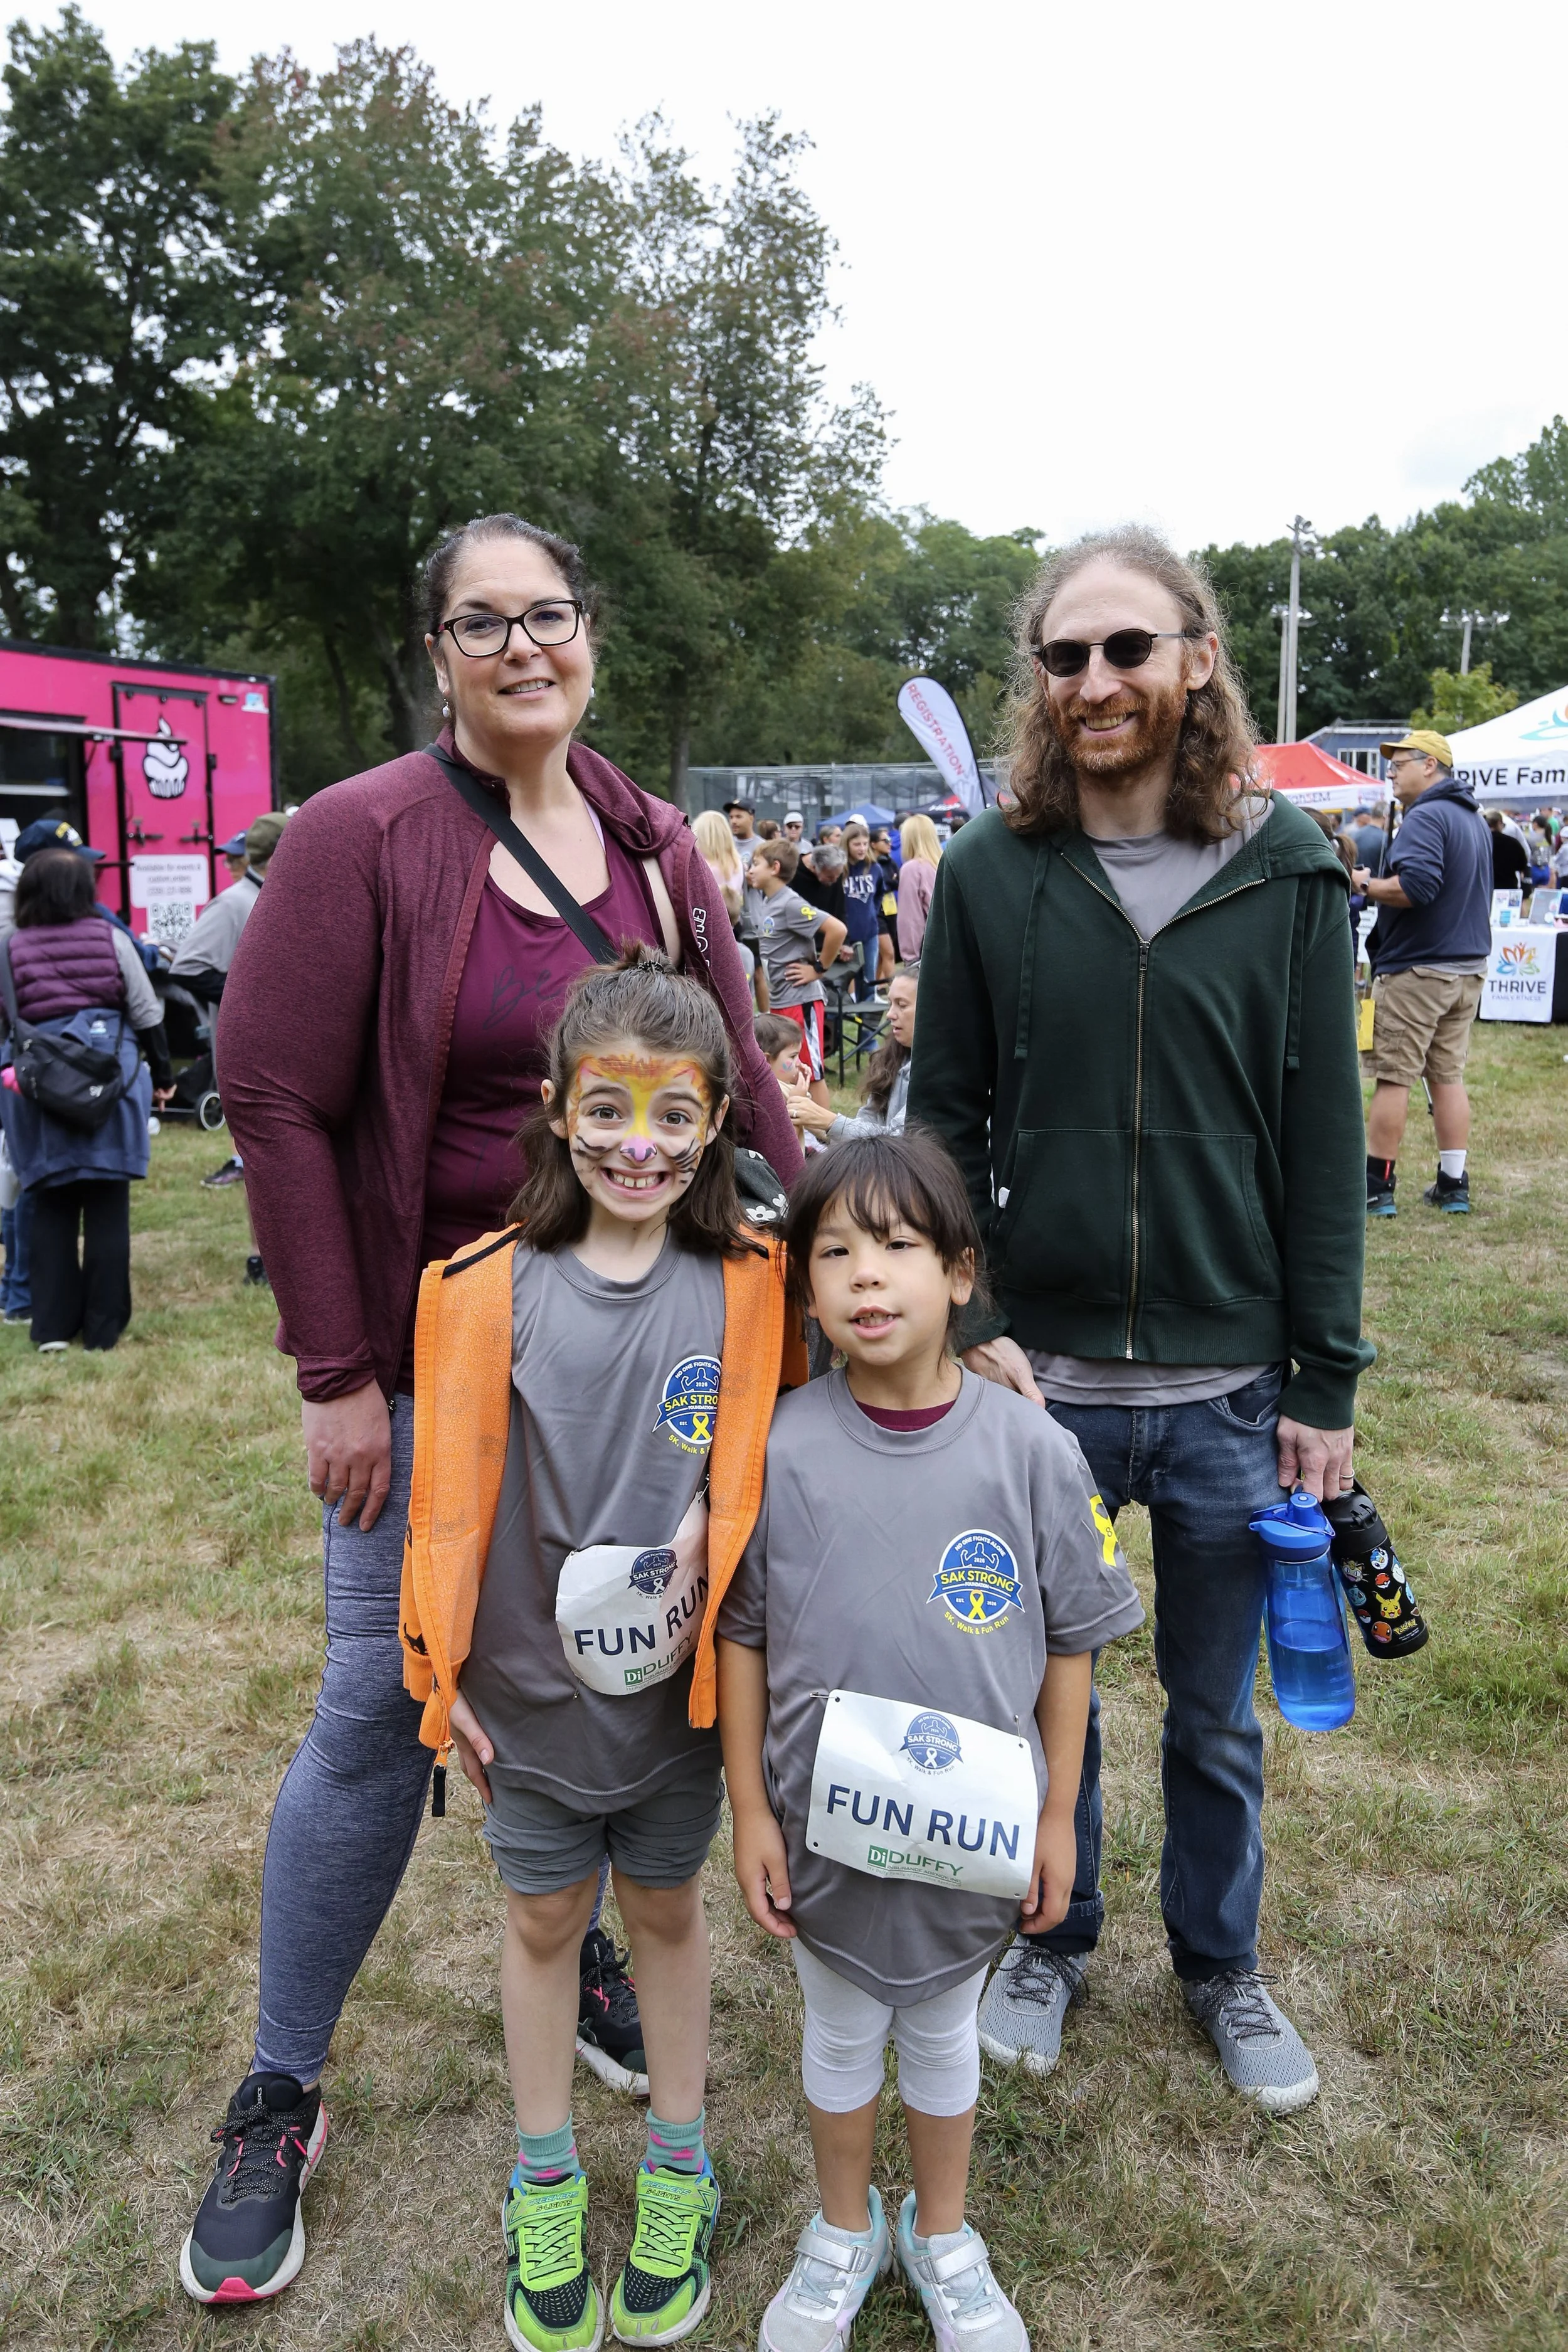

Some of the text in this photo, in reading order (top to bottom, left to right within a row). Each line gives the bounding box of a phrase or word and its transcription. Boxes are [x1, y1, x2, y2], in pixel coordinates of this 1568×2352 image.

[907, 682, 965, 776] REGISTRATION
[1452, 767, 1568, 787] RIVE Fam
[1488, 980, 1547, 994] THRIVE
[682, 1363, 693, 1372] ONE
[664, 1394, 718, 1411] SAK STRO
[669, 1434, 679, 1447] 5K,
[681, 1443, 697, 1454] Walk
[955, 1542, 963, 1551] NO
[990, 1540, 1007, 1557] ALONE
[633, 1562, 675, 1581] SAK STRONG
[941, 1570, 1015, 1592] SAK STRONG
[944, 1611, 955, 1625] 5K,
[956, 1621, 973, 1634] Walk
[981, 1626, 993, 1634] Fun
[994, 1616, 1009, 1628] Run
[574, 1624, 656, 1656] FUN
[626, 1671, 642, 1683] Di
[643, 1631, 693, 1675] DUFFY
[908, 1735, 958, 1751] SAK STRONG
[914, 1765, 926, 1774] Walk
[945, 1765, 955, 1773] Run
[827, 1783, 1020, 1860] FUN RUN
[870, 1848, 964, 1876] Di DUFFY
[887, 1865, 923, 1873] INSURANCE
[642, 2180, 692, 2195] SKECHERS
[646, 2188, 681, 2201] S-LIGHTS
[527, 2191, 579, 2206] SKECHERS
[536, 2199, 573, 2212] S-LIGHTS
